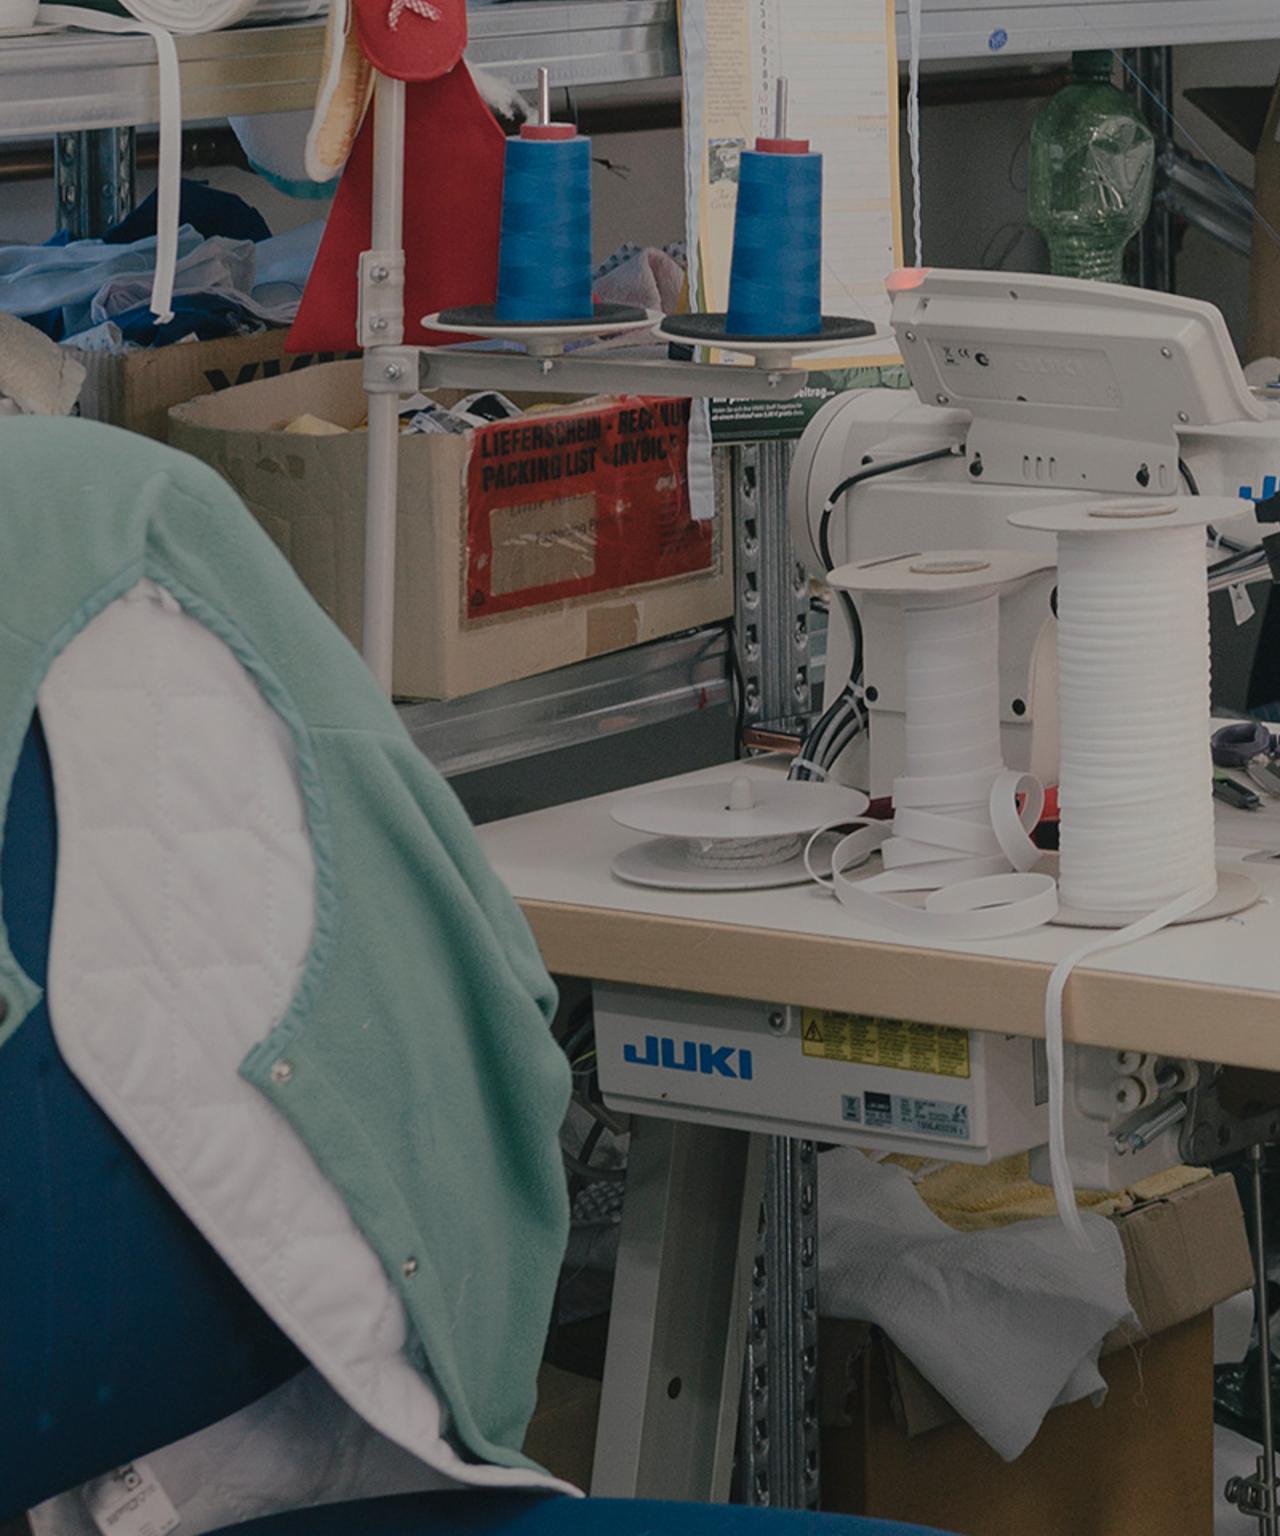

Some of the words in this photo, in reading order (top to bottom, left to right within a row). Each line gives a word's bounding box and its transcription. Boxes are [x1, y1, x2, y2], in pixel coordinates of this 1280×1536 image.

[481, 415, 602, 459] LIEFERSCHEIN
[481, 455, 561, 492] PACKING
[565, 448, 597, 476] LIST
[623, 1034, 753, 1081] JUKI
